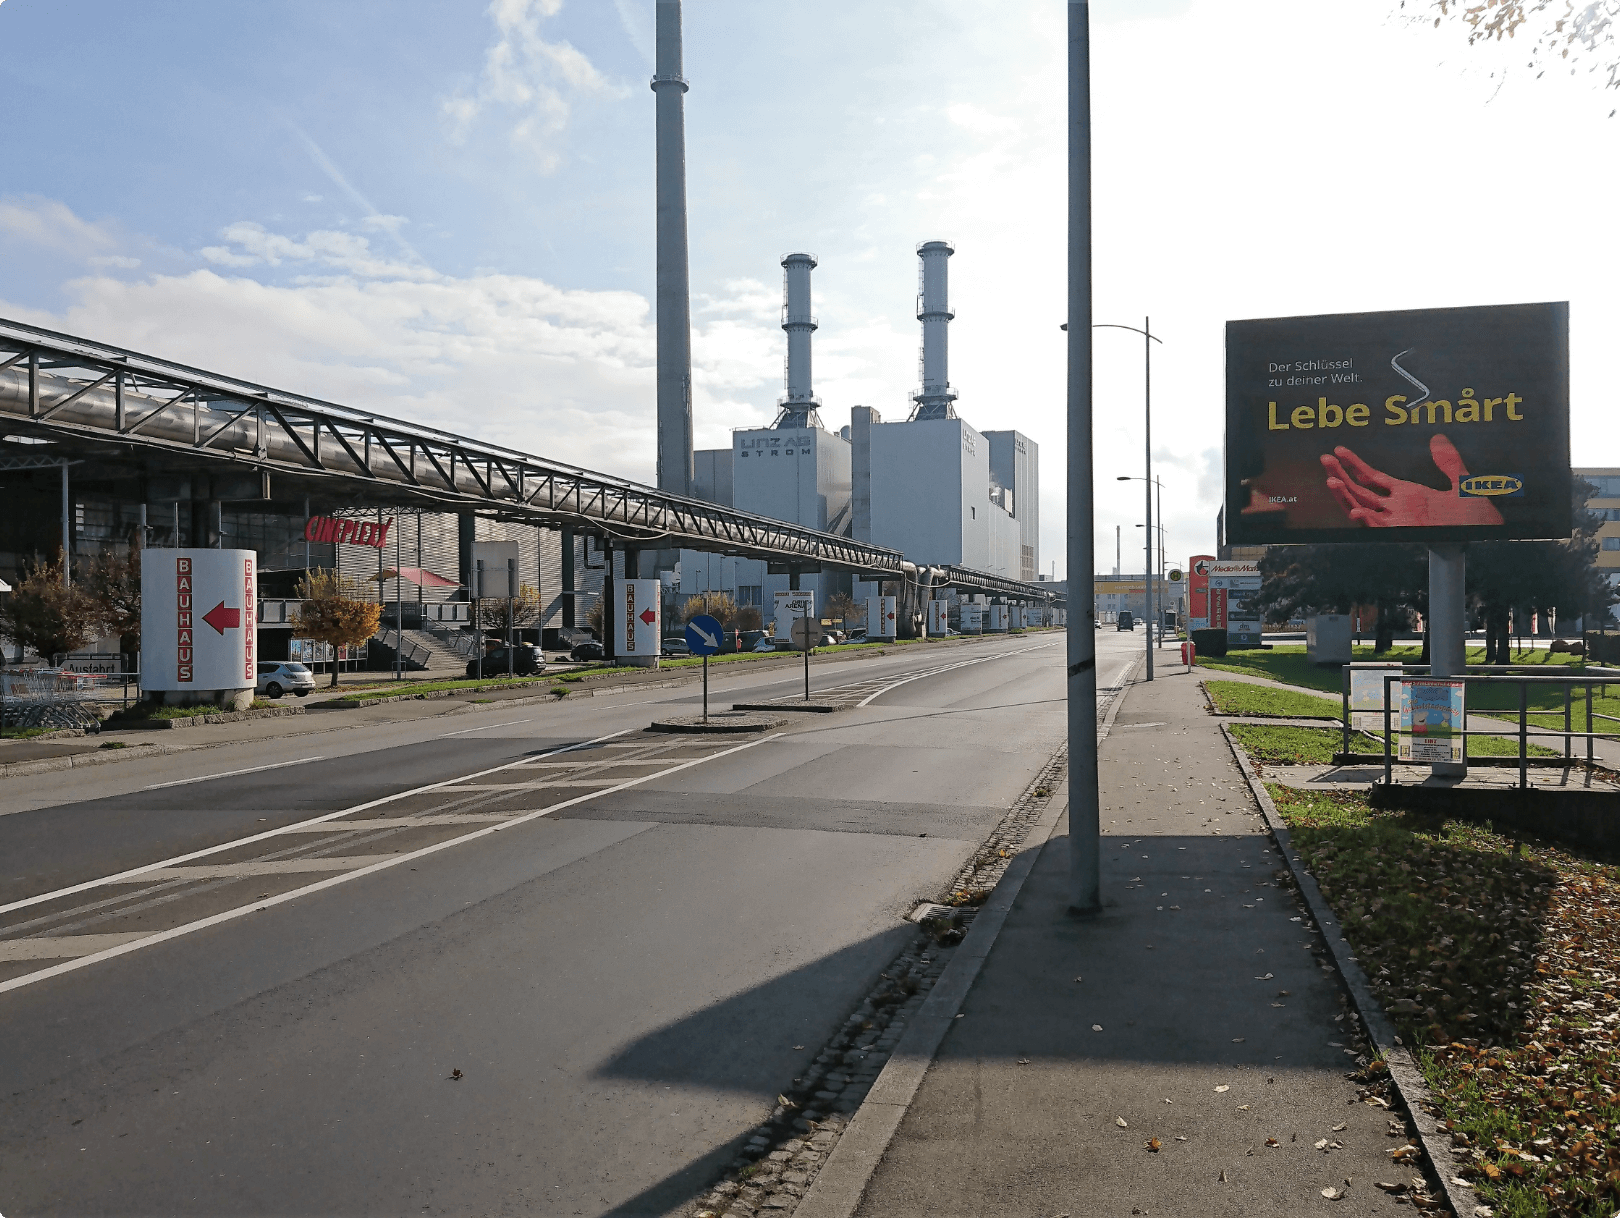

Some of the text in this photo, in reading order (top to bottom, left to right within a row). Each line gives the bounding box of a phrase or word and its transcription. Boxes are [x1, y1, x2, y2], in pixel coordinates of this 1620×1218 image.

[1268, 373, 1363, 387] zu deiner Welt.
[1269, 358, 1354, 373] Der Schlüssel
[1268, 387, 1524, 431] Lebe Smårt
[741, 448, 811, 458] STROM
[1465, 480, 1519, 491] IKEA
[304, 515, 395, 548] CINEPLEXX
[178, 559, 192, 680] BAUHAUS
[245, 560, 253, 678] BAUHAUS
[626, 585, 635, 650] BAUHAUS
